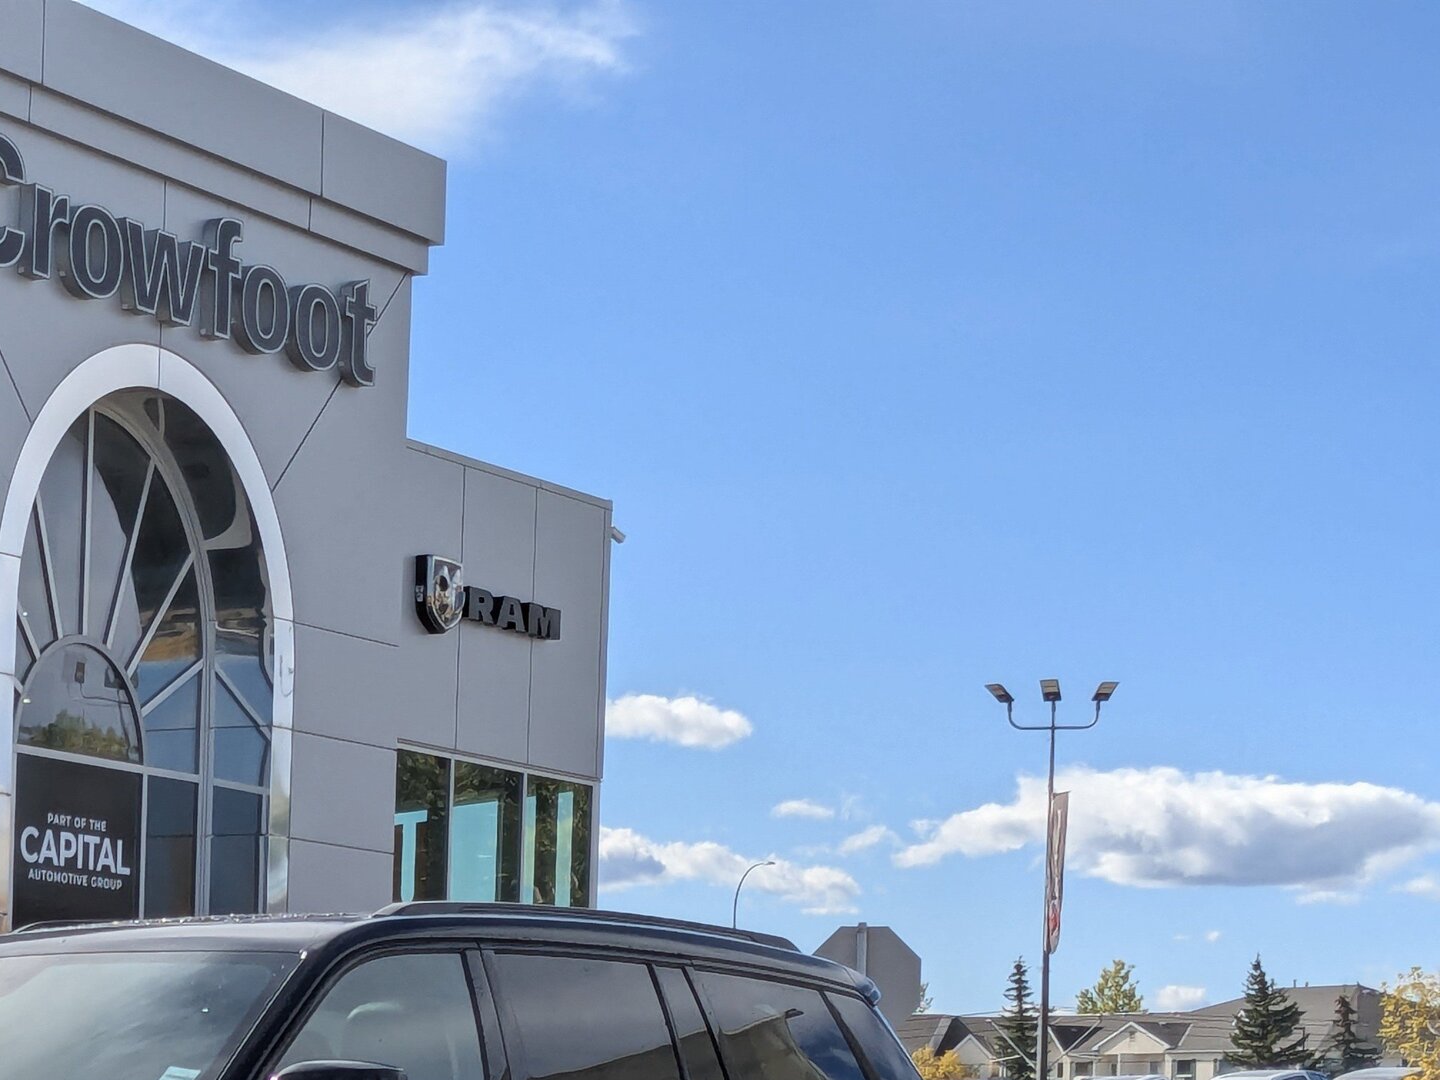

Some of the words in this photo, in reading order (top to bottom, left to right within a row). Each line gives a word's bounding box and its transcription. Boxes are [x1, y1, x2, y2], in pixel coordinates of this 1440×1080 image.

[464, 586, 561, 641] RAM
[47, 812, 72, 828] PART
[74, 817, 87, 829] OF
[89, 819, 107, 832] THE
[20, 826, 131, 876] CAPITAL
[27, 868, 88, 887] AUTOMOTIVE
[90, 876, 122, 890] GROUP
